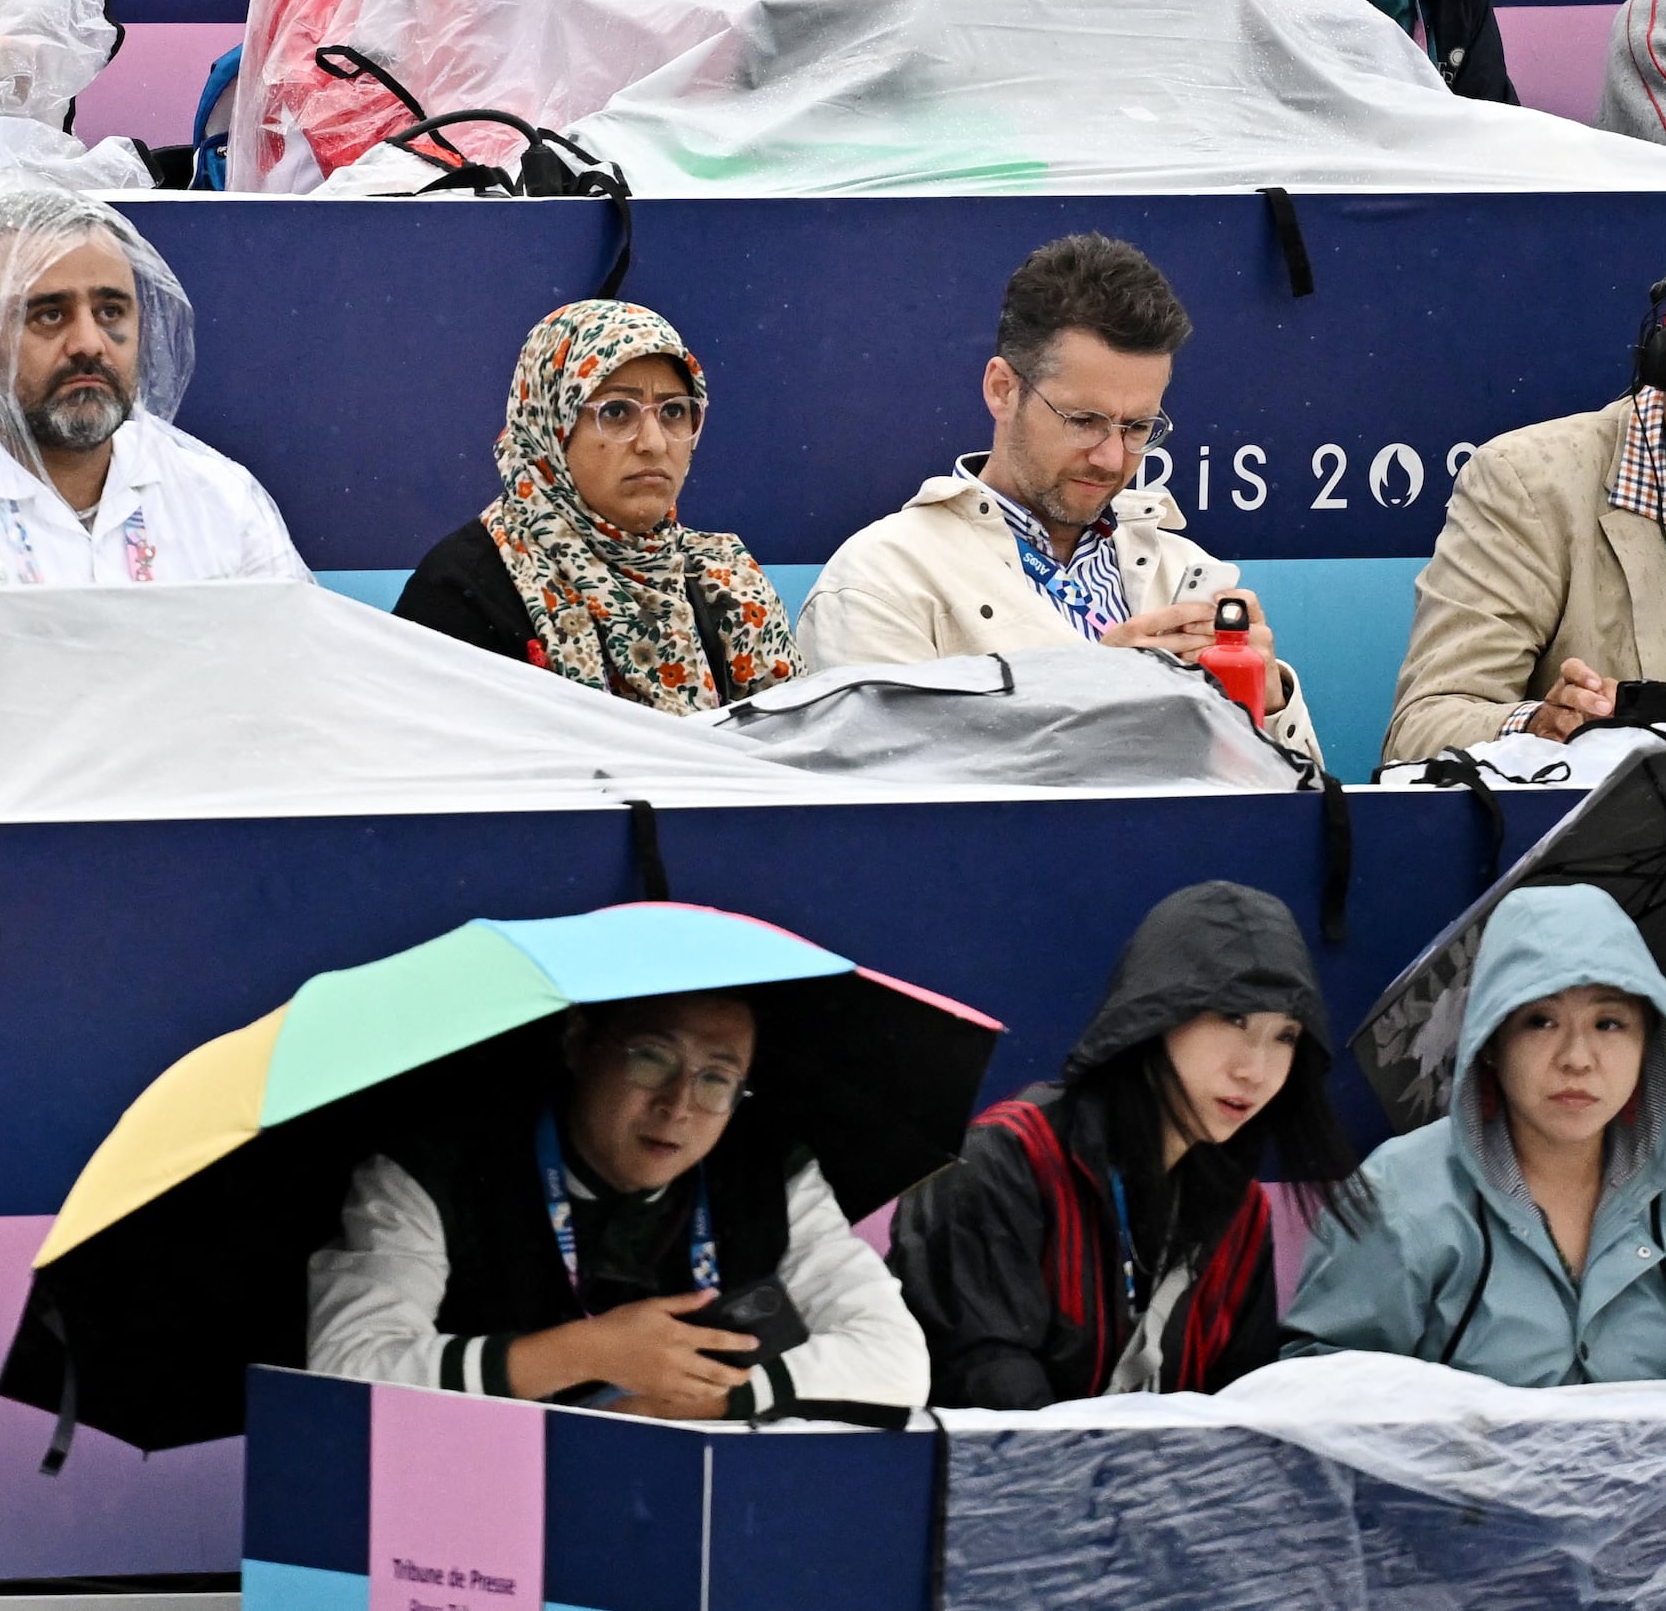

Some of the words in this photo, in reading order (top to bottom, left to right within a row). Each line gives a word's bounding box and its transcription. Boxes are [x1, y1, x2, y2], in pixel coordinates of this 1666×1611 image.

[1023, 552, 1050, 576] Atos
[393, 1559, 445, 1586] Tribune
[448, 1565, 467, 1589] de
[470, 1570, 518, 1596] Presse
